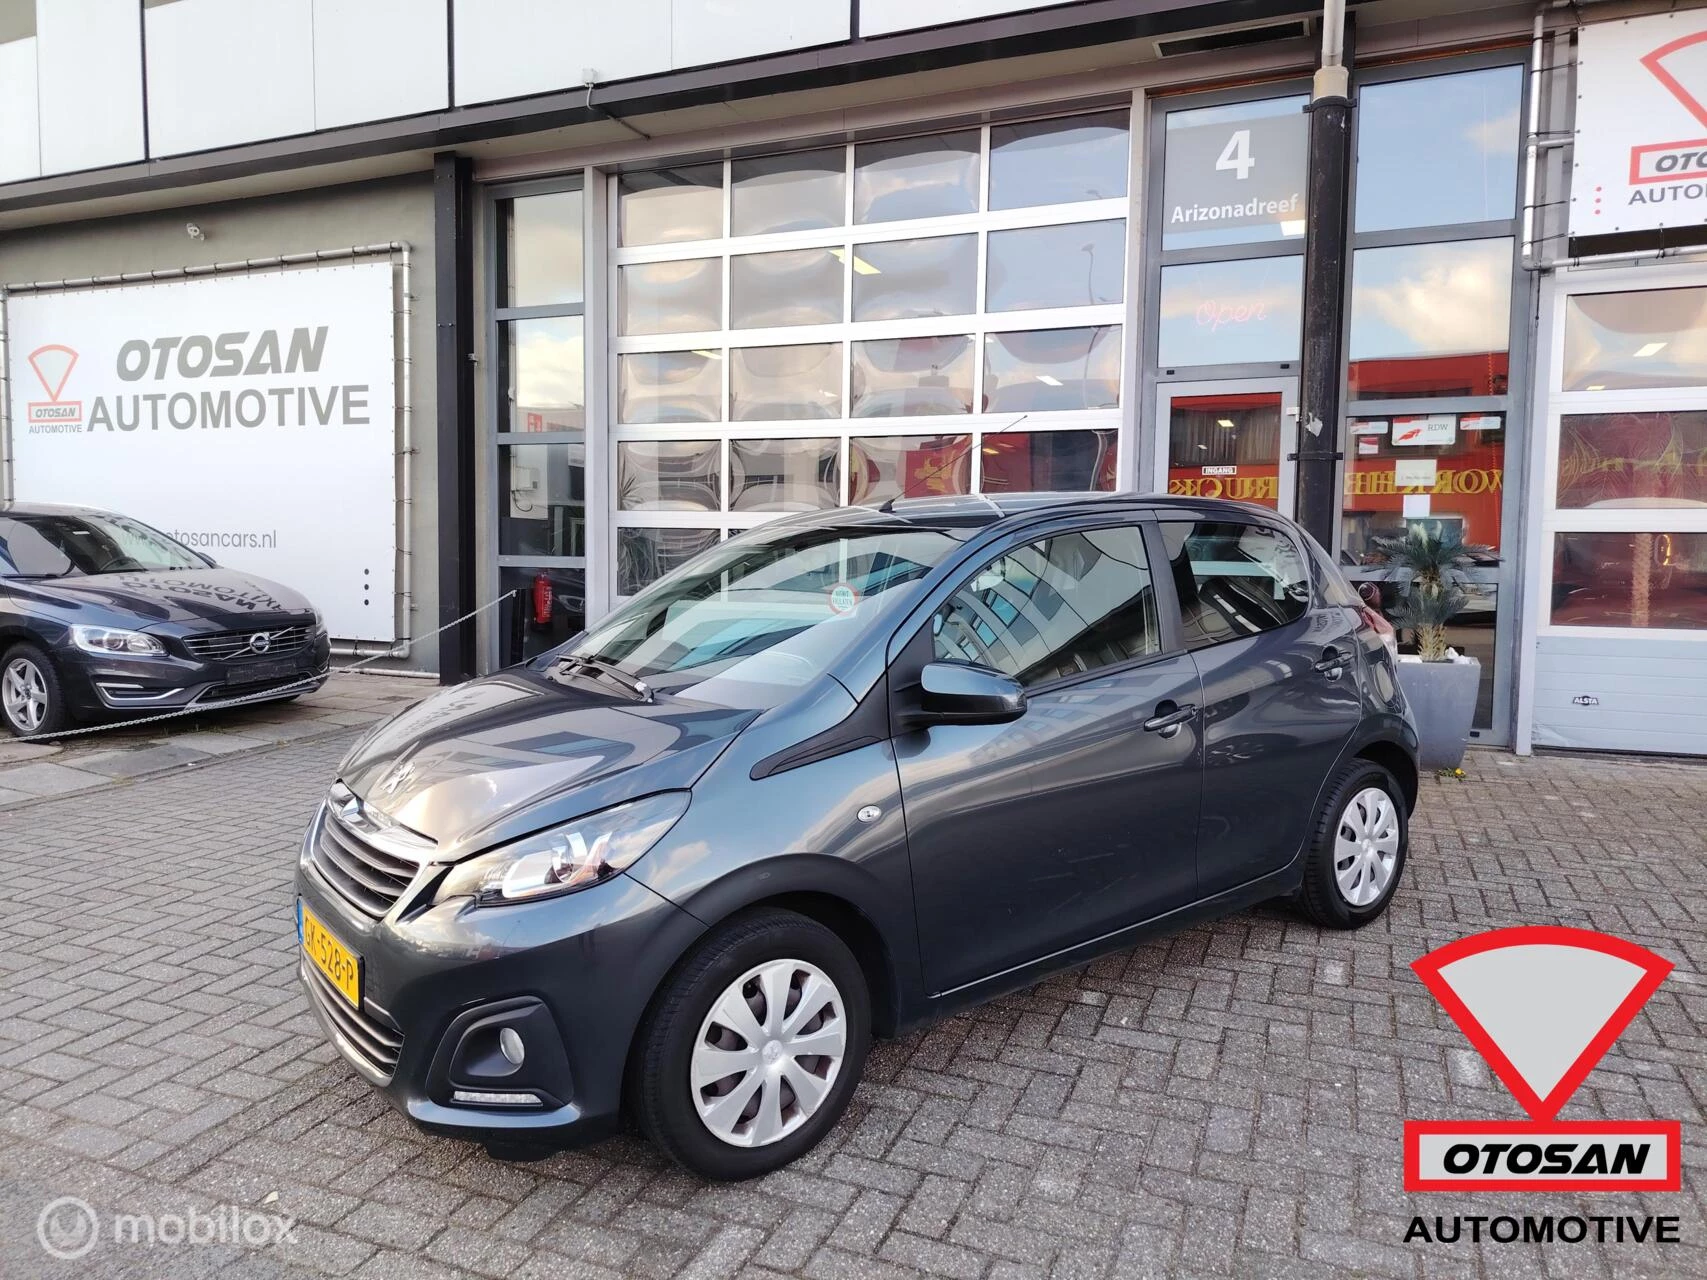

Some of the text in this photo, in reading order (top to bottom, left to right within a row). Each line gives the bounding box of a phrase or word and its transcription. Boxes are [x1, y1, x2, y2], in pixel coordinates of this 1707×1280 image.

[1215, 129, 1256, 180] 4
[1628, 183, 1707, 206] AUTO
[1171, 193, 1300, 224] Arizonadreef
[116, 326, 329, 382] OTOSAN
[35, 407, 76, 418] OTOSAN
[87, 384, 371, 432] AUTOMOTIVE
[29, 424, 83, 434] AUTOMOTIVE
[1427, 423, 1449, 432] RDW
[1205, 466, 1234, 475] INGANG
